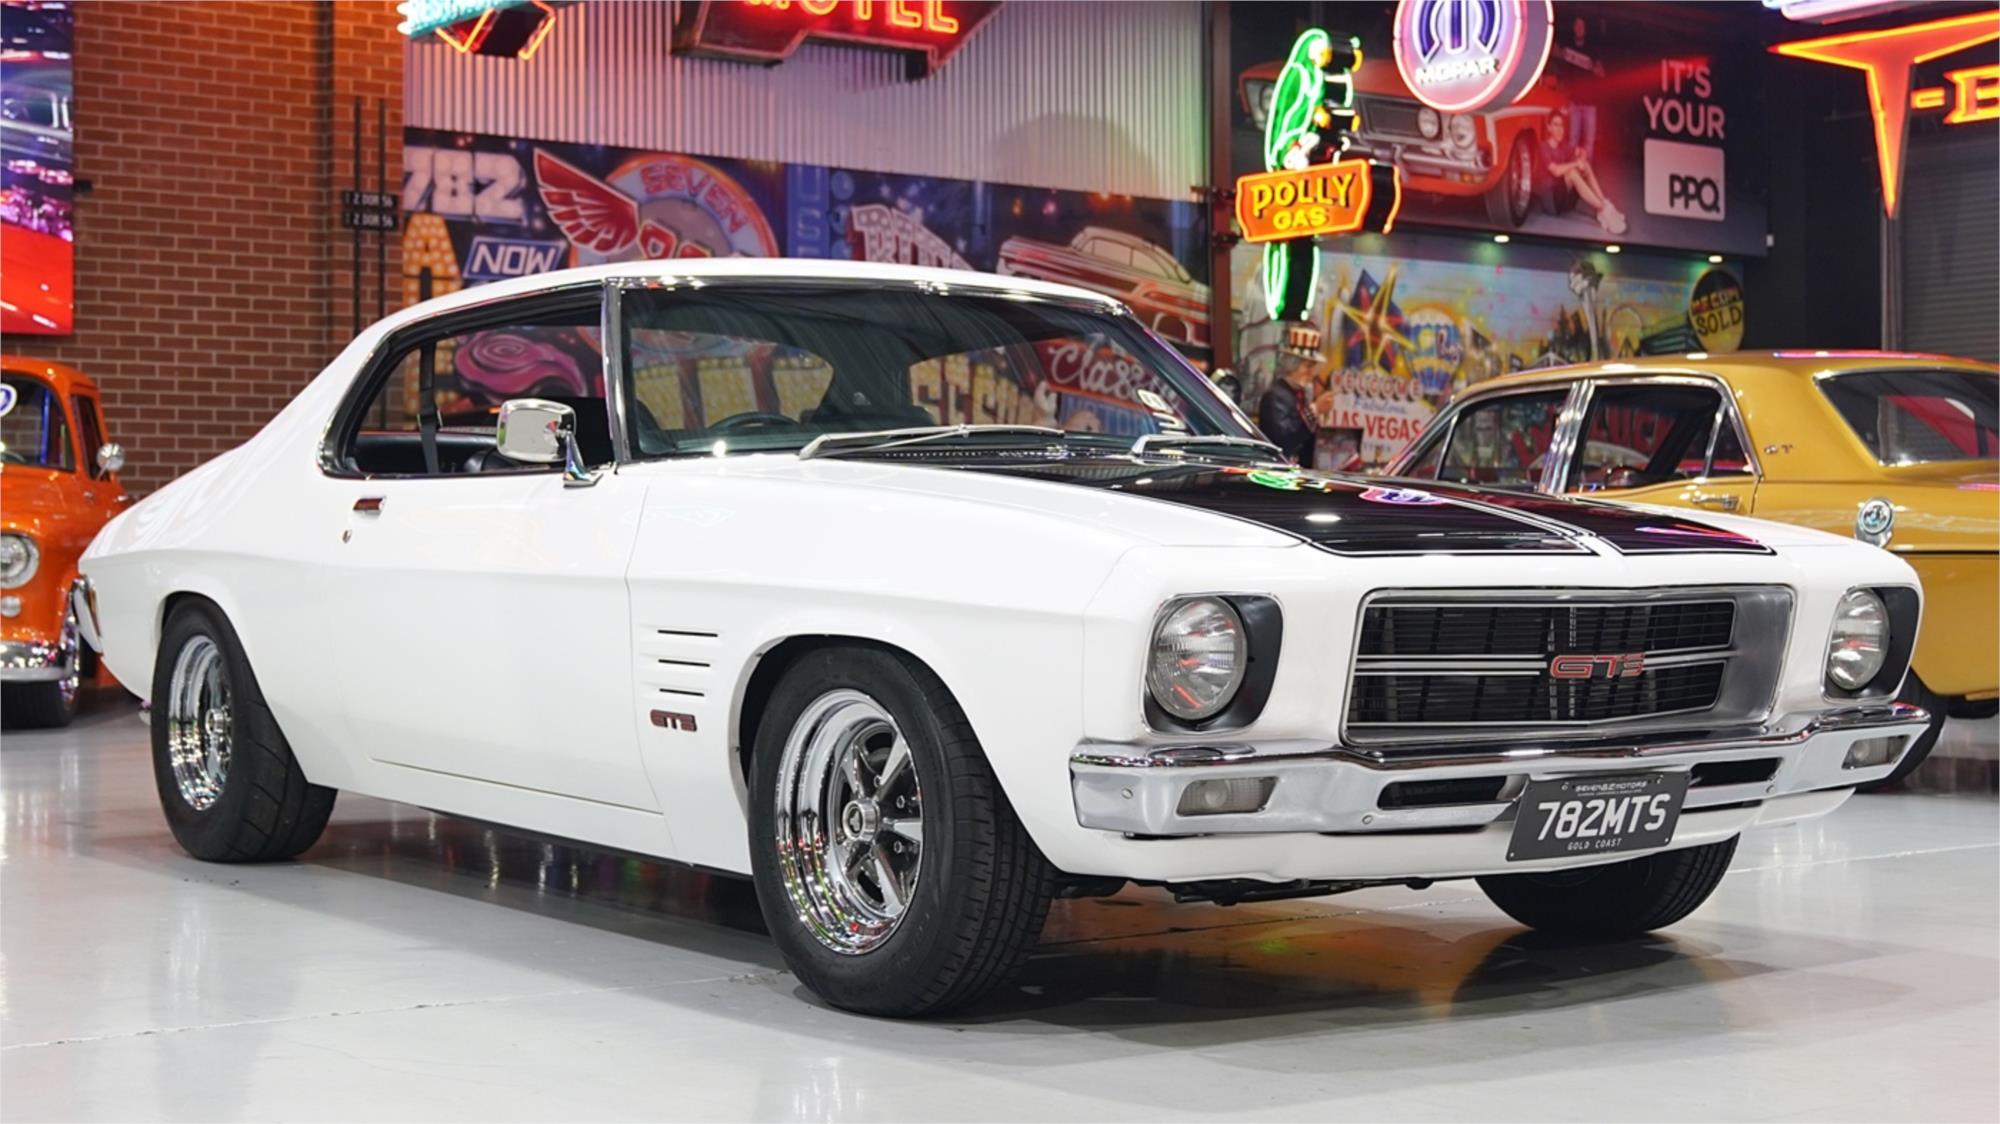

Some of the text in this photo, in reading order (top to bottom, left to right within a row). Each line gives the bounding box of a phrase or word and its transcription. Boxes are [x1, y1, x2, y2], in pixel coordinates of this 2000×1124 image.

[1416, 57, 1501, 84] MOPAR
[1661, 59, 1711, 98] IT'S
[1643, 96, 1724, 139] YOUR
[403, 147, 525, 226] 782
[1250, 173, 1353, 217] POLLY
[1669, 174, 1720, 213] PPQ
[1273, 206, 1327, 230] GAS
[471, 244, 556, 275] NOW
[1696, 305, 1742, 337] SOLD
[1365, 414, 1421, 441] VEGAS
[1550, 652, 1645, 678] GTS
[1537, 793, 1671, 841] 782MTS
[1567, 837, 1622, 850] GOLD COAST
